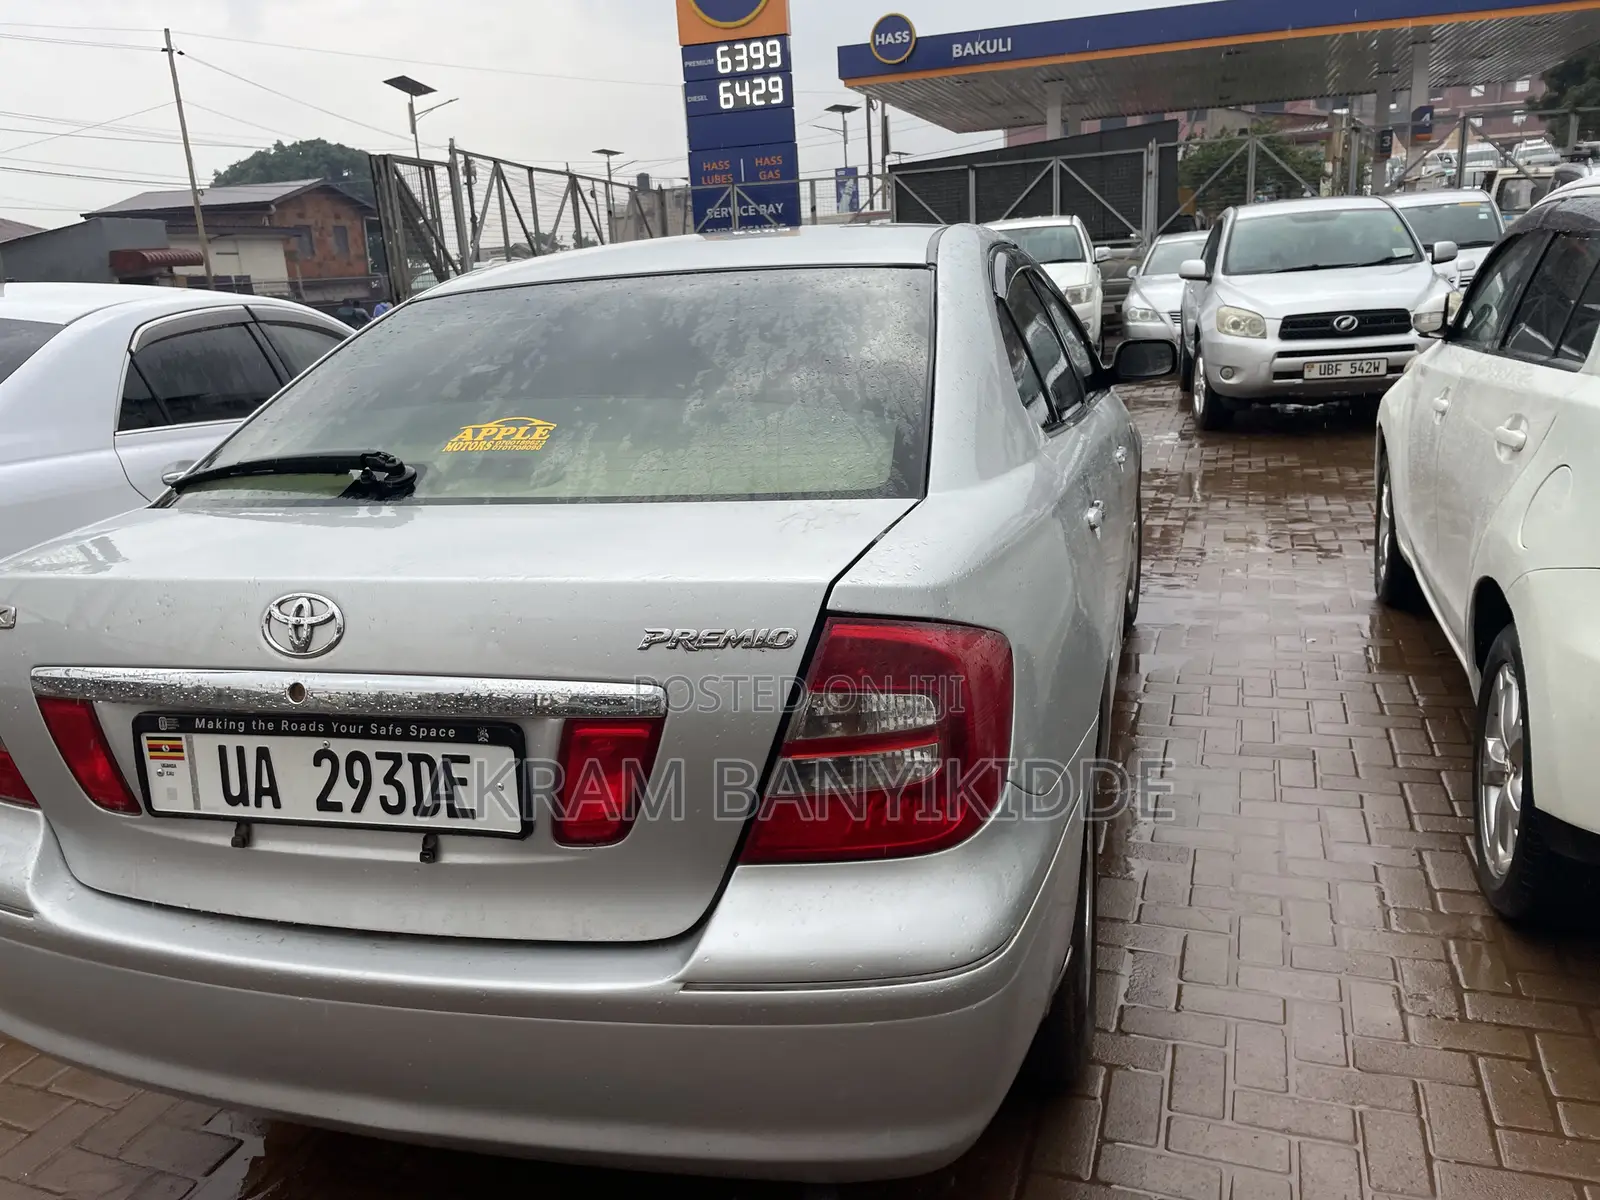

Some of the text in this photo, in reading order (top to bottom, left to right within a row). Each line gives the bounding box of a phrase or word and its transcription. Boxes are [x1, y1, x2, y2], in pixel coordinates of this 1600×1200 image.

[875, 31, 910, 46] HASS
[952, 37, 1012, 58] BAKULI
[716, 39, 782, 74] 6399
[719, 76, 784, 109] 6429
[703, 160, 731, 171] HASS
[755, 155, 783, 167] HASS
[702, 174, 734, 185] LUBES
[759, 169, 781, 181] GAS
[760, 202, 784, 215] BAY
[1319, 363, 1342, 376] UBF
[450, 426, 555, 442] APPLE
[442, 440, 494, 452] MOTORS
[637, 627, 799, 651] PREMIO
[195, 717, 246, 732] Making
[251, 719, 275, 731] the
[281, 720, 325, 733] Roads
[331, 721, 364, 734] Your
[370, 723, 402, 736] Safe
[409, 725, 456, 739] Space
[217, 744, 477, 820] UA 293DE
